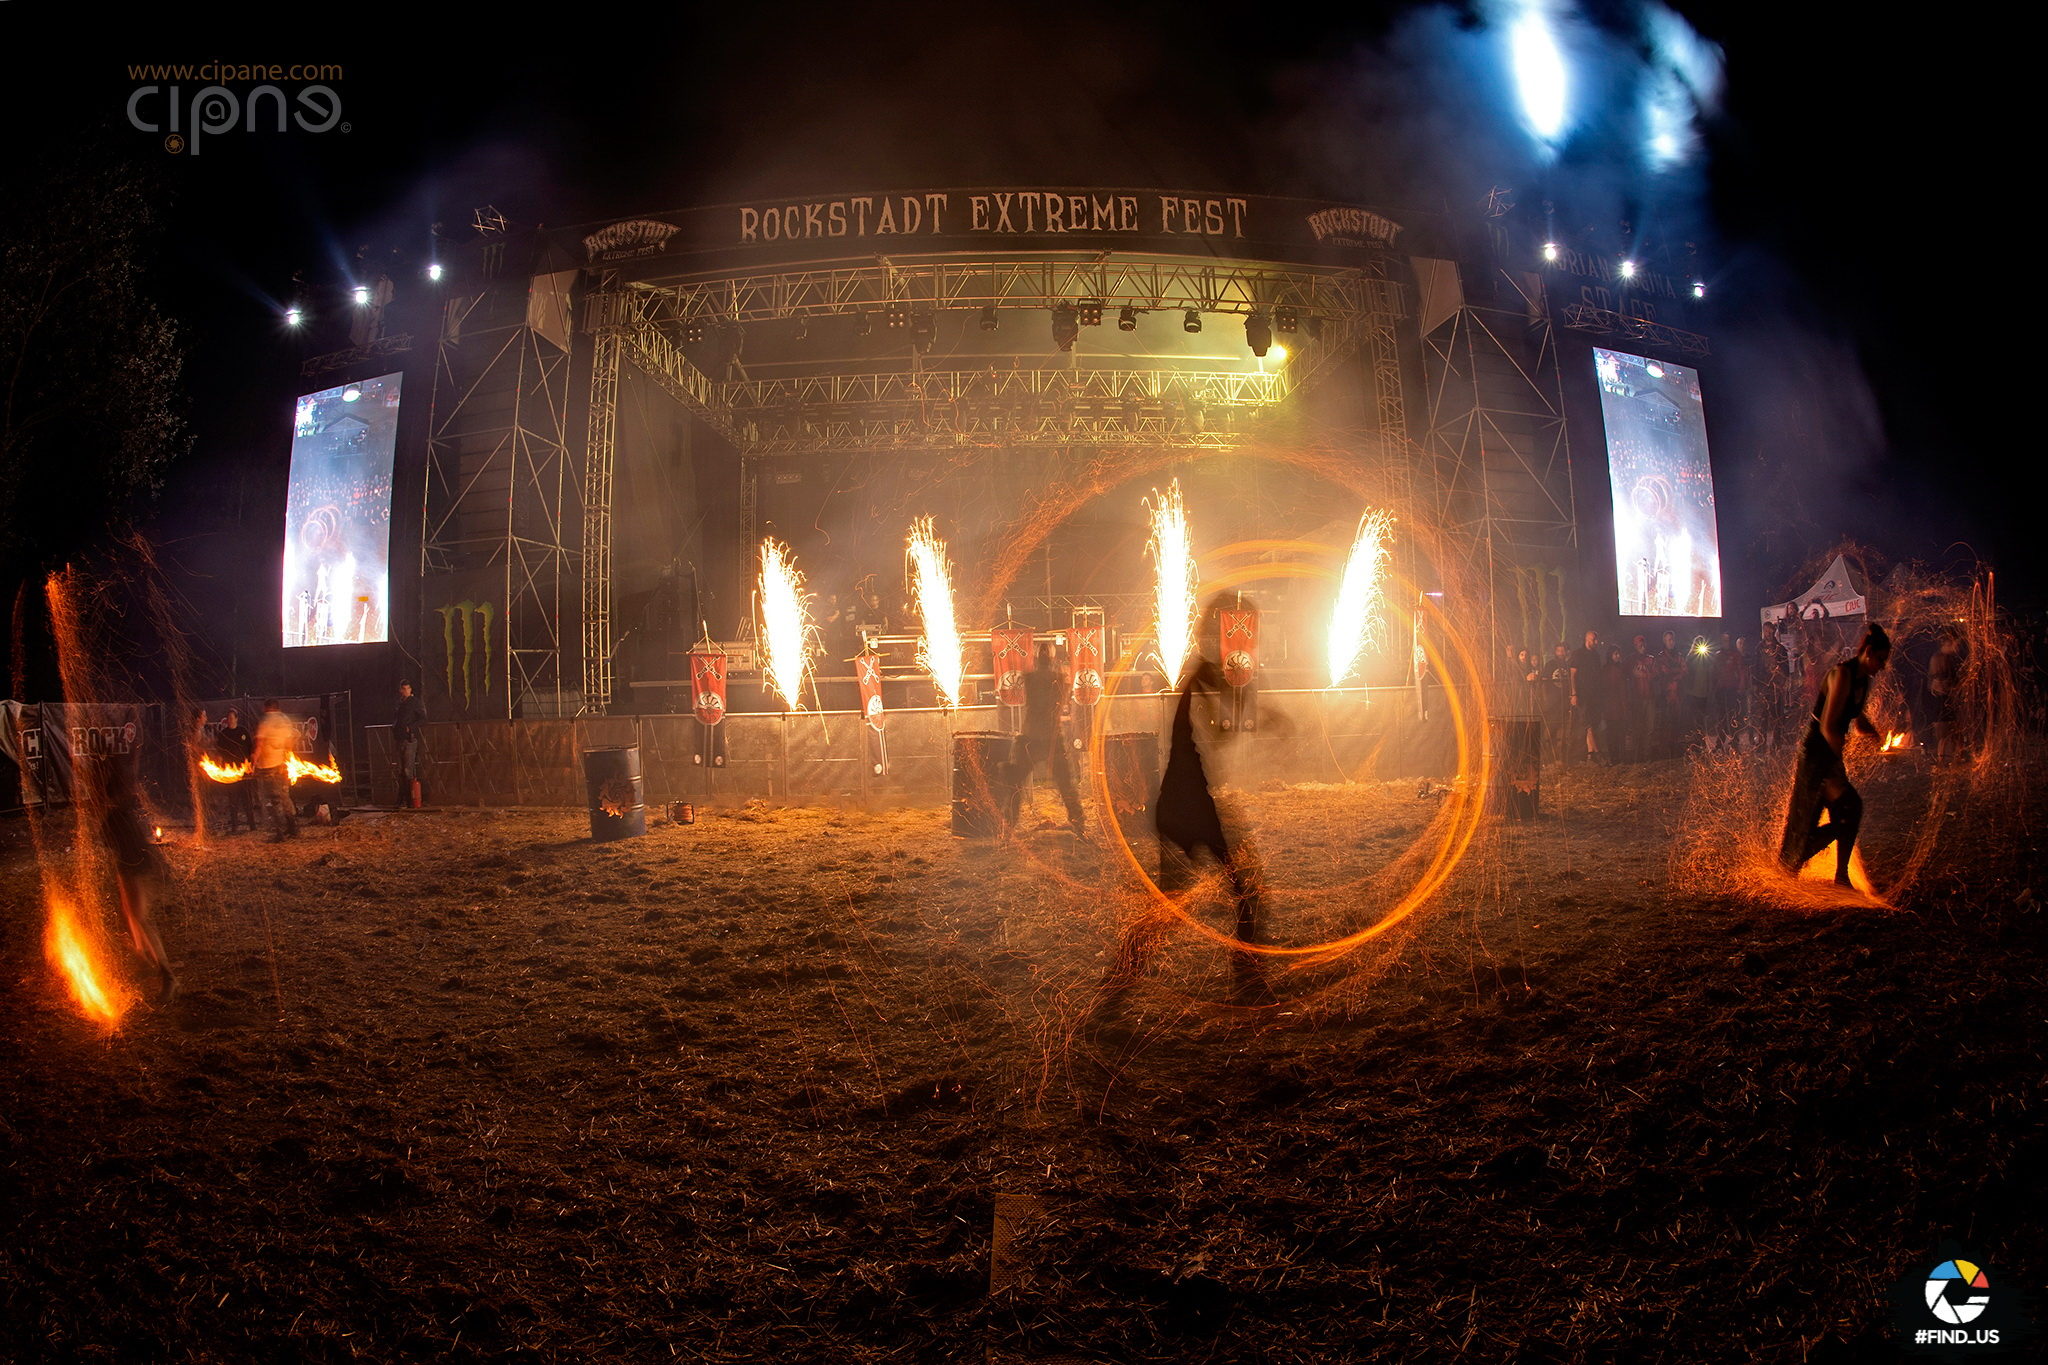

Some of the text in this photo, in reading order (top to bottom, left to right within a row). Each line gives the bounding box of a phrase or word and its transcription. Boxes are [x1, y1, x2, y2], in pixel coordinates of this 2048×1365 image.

[738, 192, 1248, 243] ROCKSTADT EXTREME FEST
[72, 726, 129, 757] ROCK
